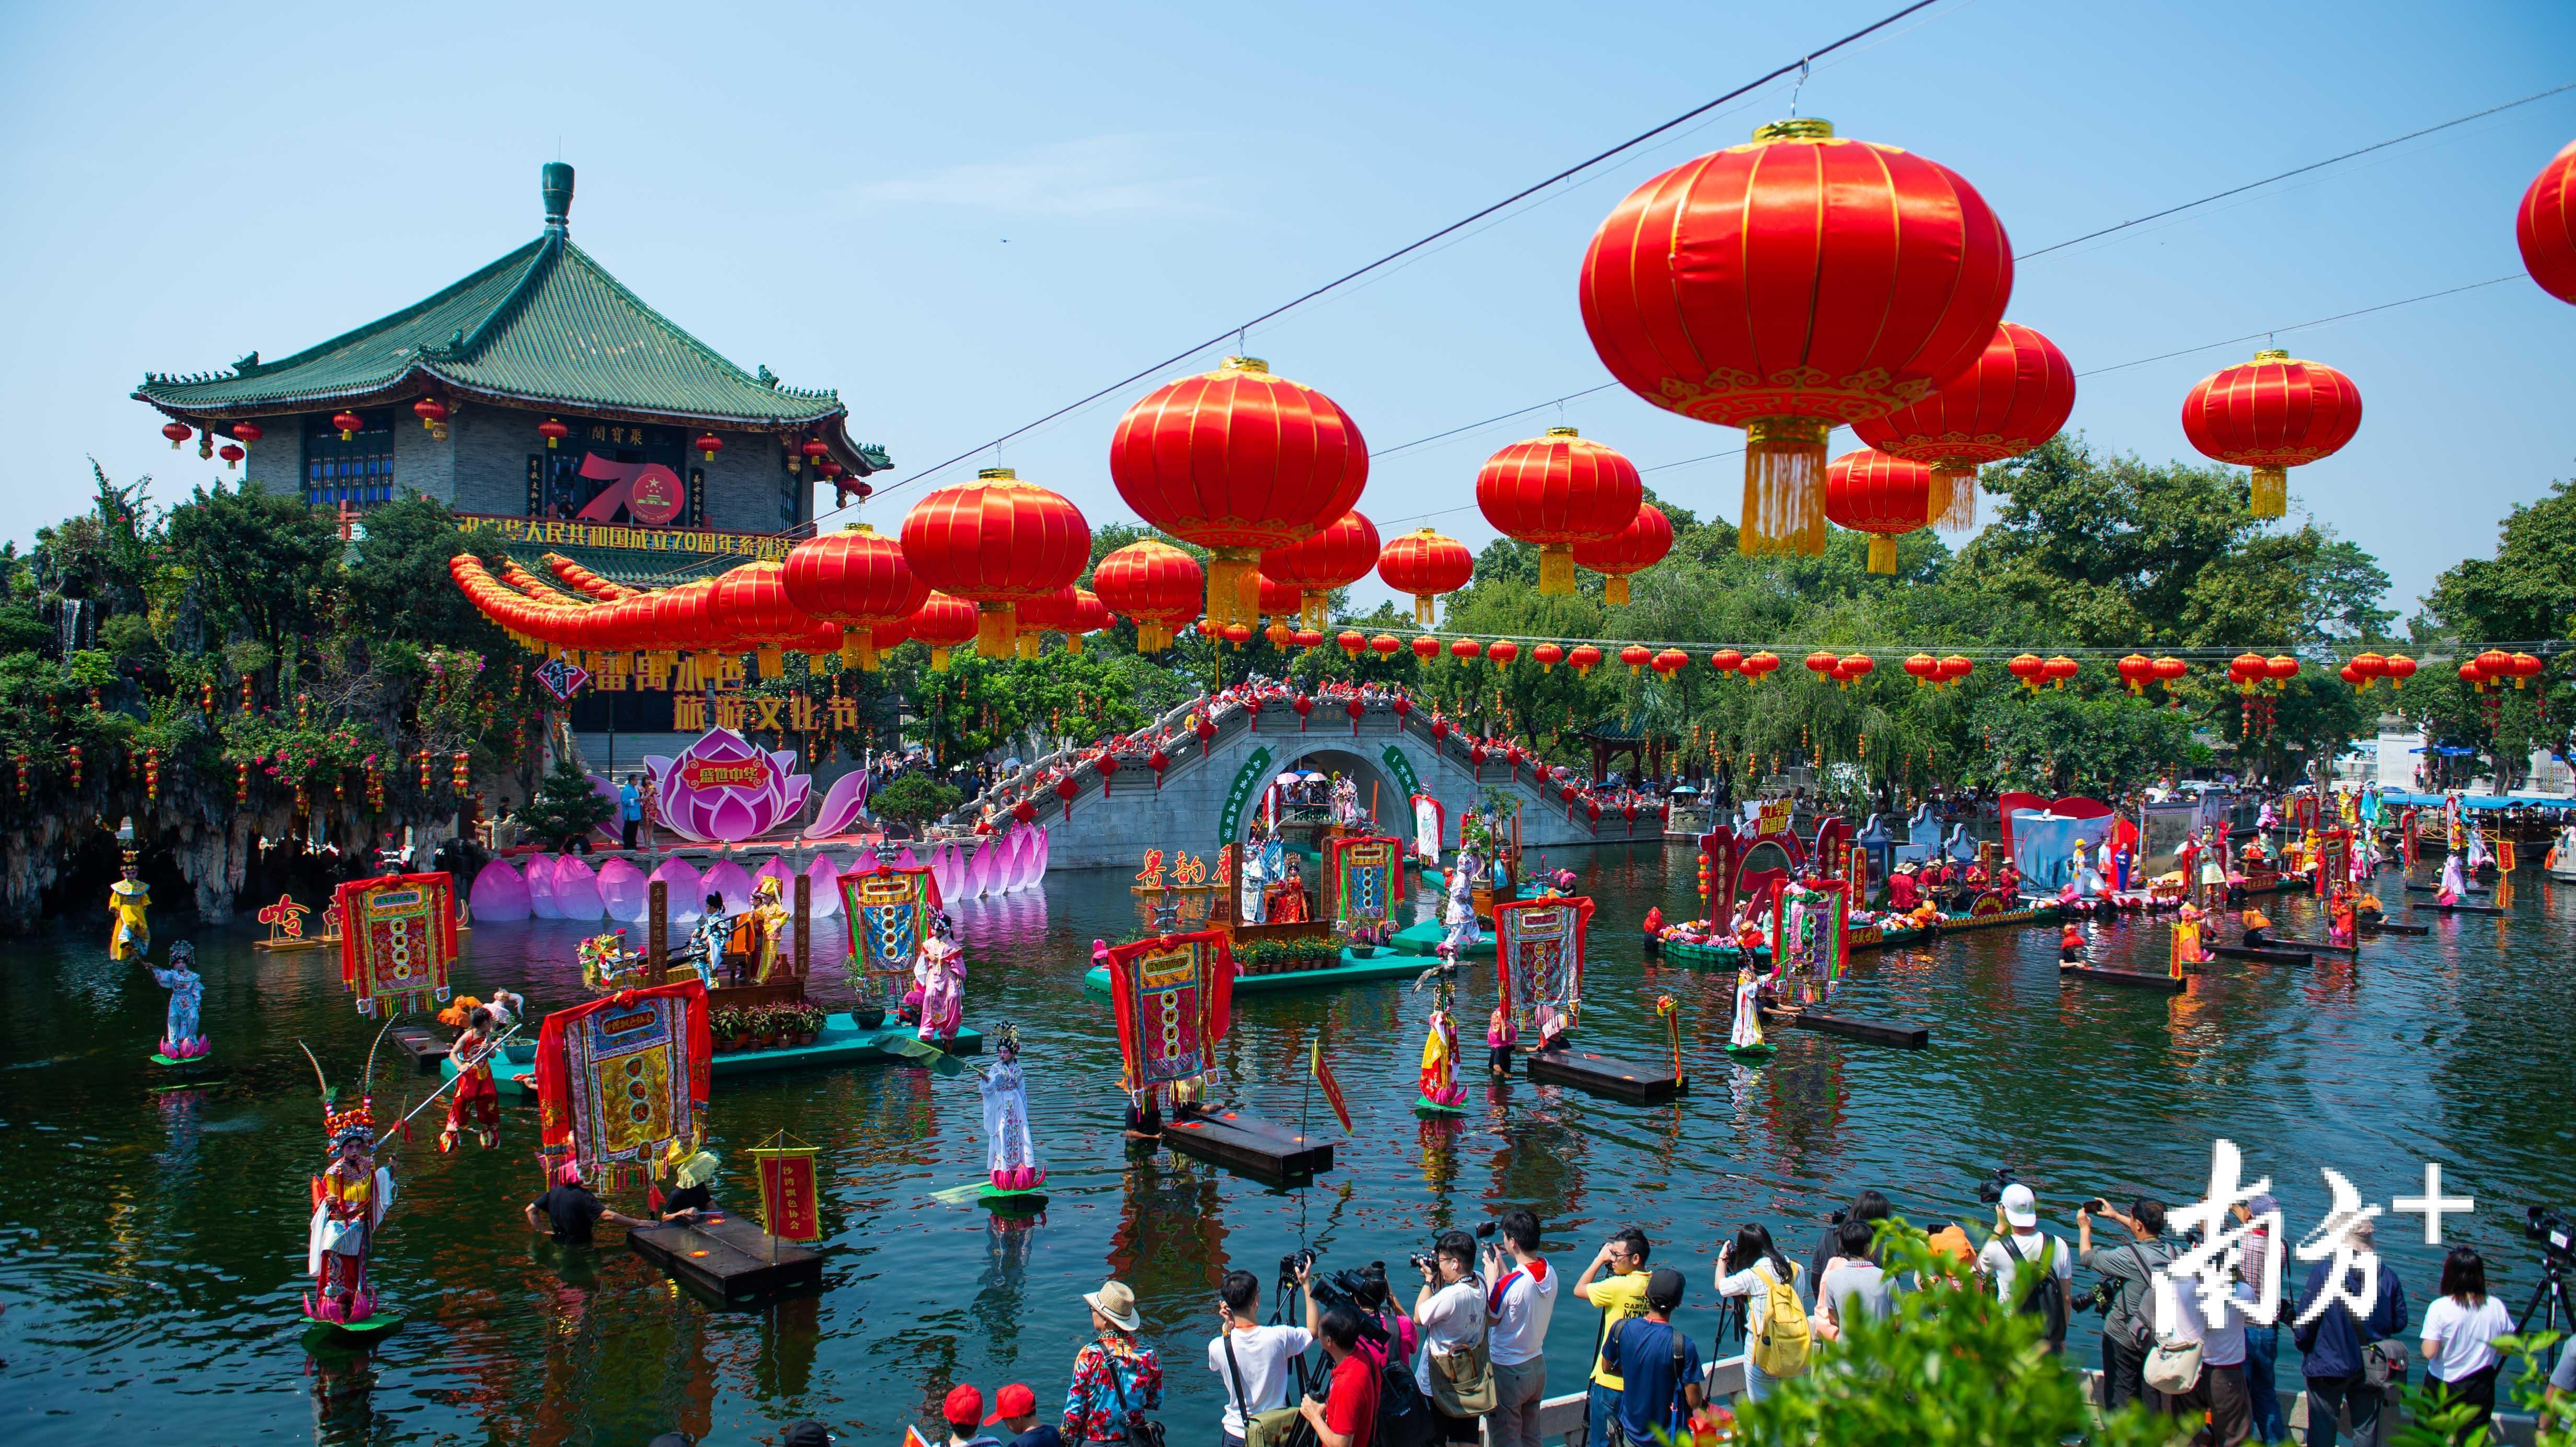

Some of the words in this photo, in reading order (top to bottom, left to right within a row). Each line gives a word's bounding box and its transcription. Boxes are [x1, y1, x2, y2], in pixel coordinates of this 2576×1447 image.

[673, 695, 857, 731] 旅游文化节
[699, 767, 757, 783] 盛世中华
[1759, 798, 1793, 818] 七十华诞
[1760, 816, 1787, 835] 欣盛世
[1848, 927, 1878, 945] 欣盛世》
[782, 1166, 800, 1230] 沙湾飘色协会
